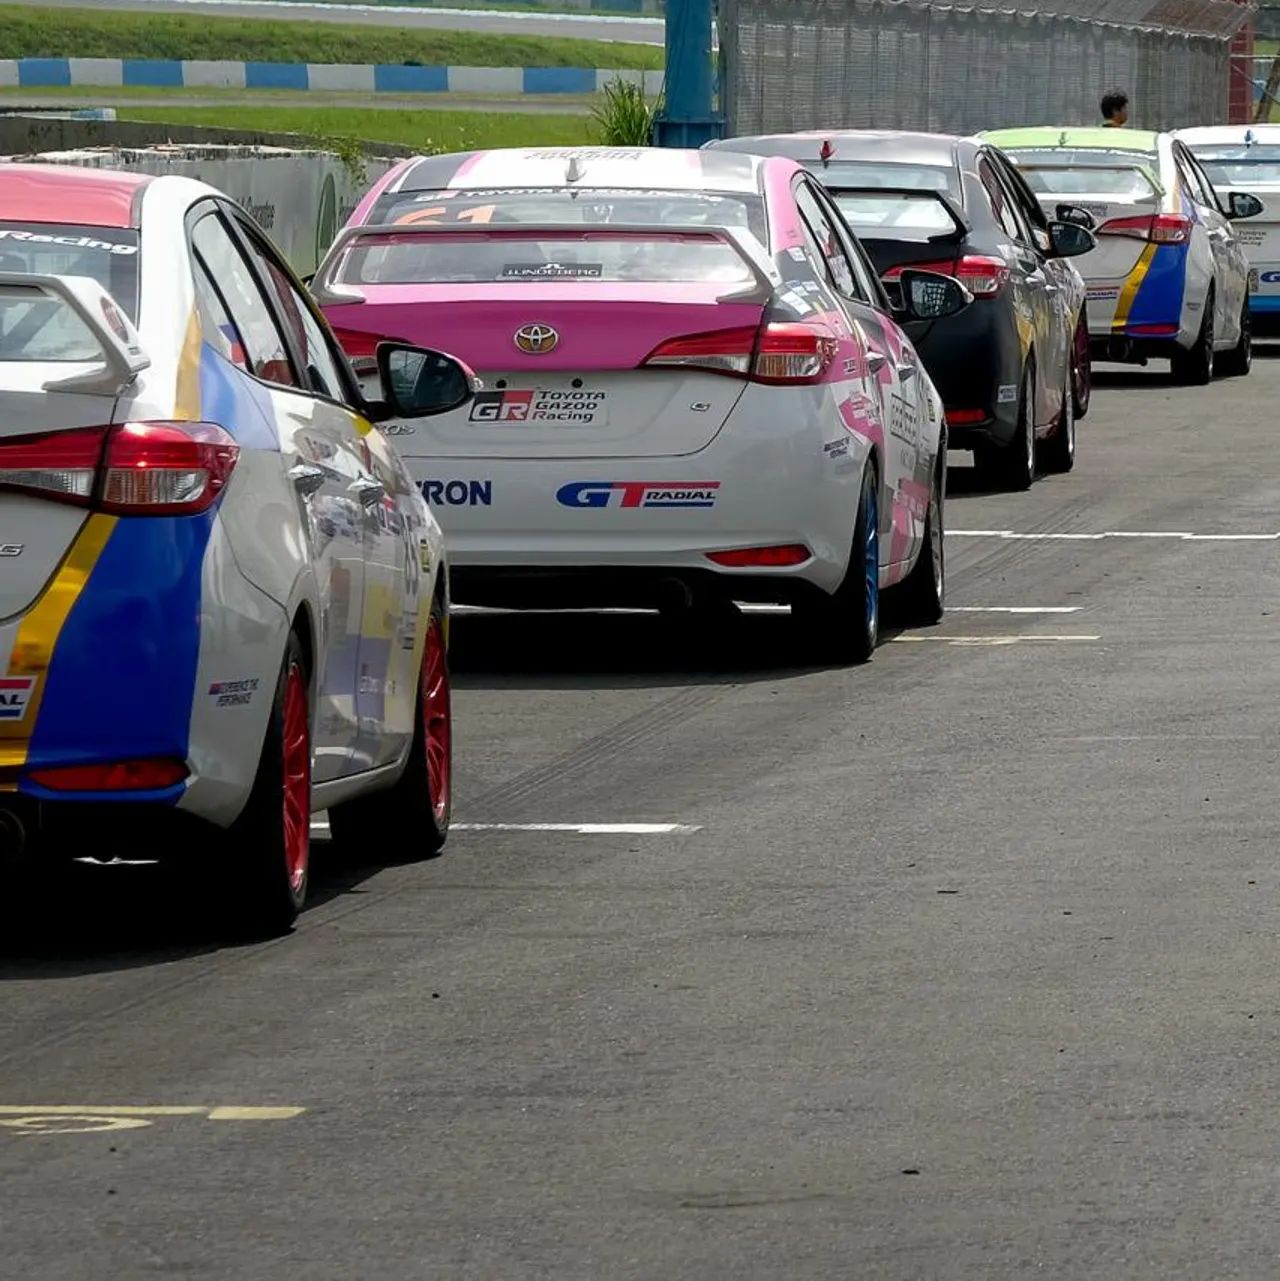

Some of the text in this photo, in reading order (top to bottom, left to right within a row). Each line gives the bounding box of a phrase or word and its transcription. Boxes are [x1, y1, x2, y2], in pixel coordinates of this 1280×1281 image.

[539, 390, 607, 401] TOYOTA
[469, 402, 529, 421] GR
[536, 401, 598, 412] GAZOO
[532, 410, 595, 424] Racing
[646, 489, 717, 500] RADIAL
